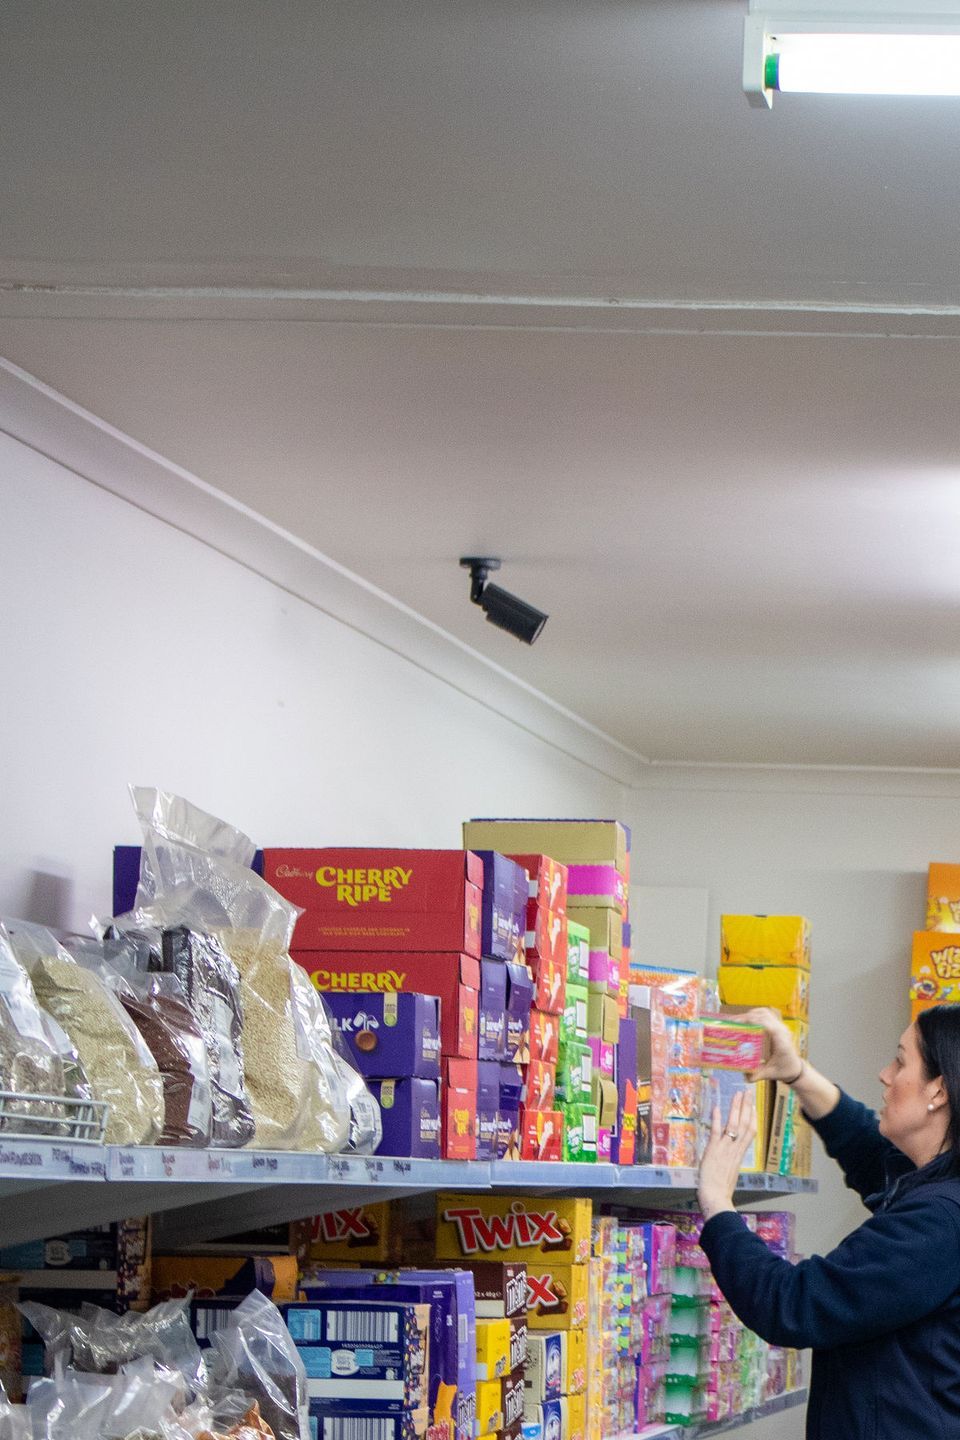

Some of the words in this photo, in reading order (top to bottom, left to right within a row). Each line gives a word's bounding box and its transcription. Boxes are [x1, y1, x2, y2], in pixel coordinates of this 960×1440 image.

[315, 866, 413, 889] CHERRY
[336, 885, 392, 907] RIPE
[310, 970, 407, 992] CHERRY
[444, 1201, 564, 1254] Twix
